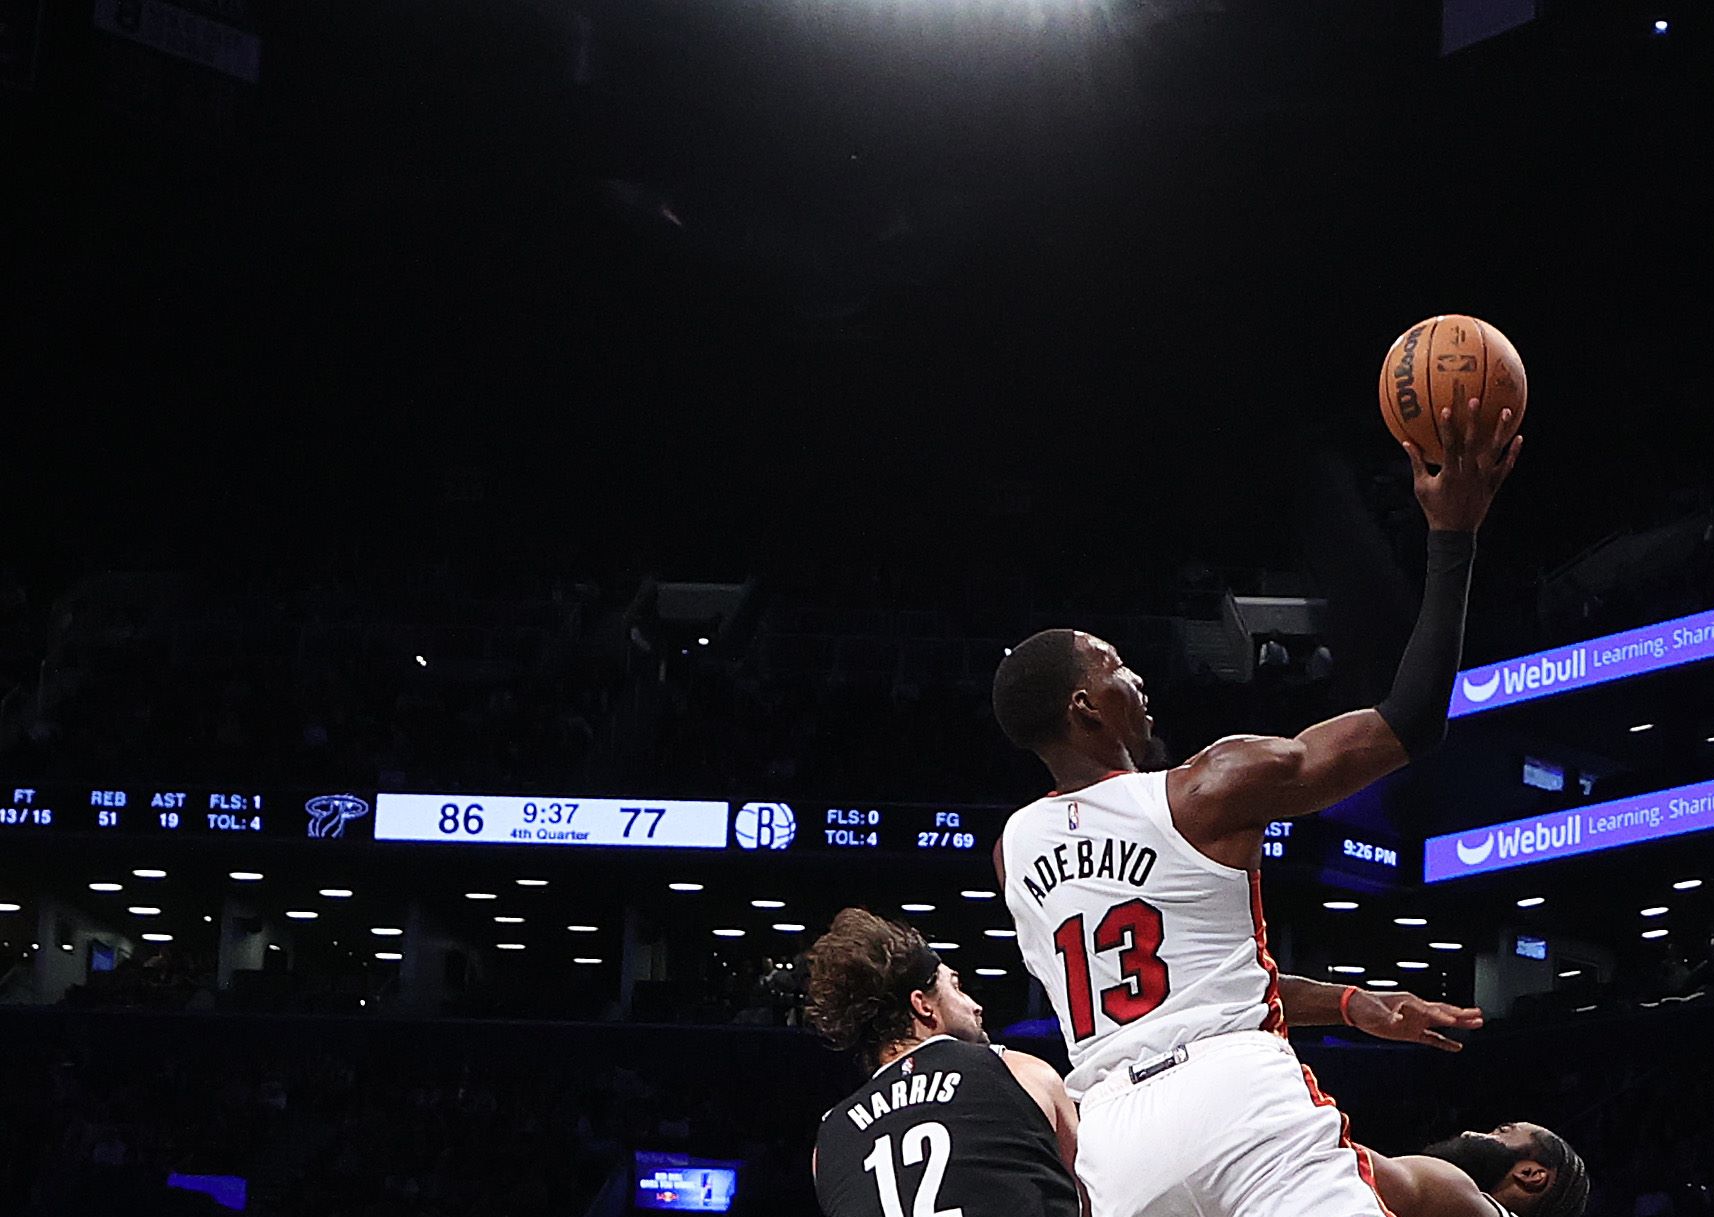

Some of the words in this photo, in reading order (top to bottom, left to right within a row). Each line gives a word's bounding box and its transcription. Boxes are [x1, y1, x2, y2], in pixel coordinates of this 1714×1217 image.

[1504, 648, 1586, 695] Webull
[1593, 637, 1668, 668] Learning.
[14, 789, 36, 803] FT
[91, 791, 127, 806] REB
[151, 793, 187, 808] AST
[98, 811, 118, 826] 51
[159, 813, 179, 828] 19
[437, 804, 485, 834] 86
[522, 803, 579, 824] 9:37
[618, 808, 667, 838] 77
[935, 813, 960, 827] FG
[537, 829, 590, 842] Quarter
[1498, 814, 1582, 859] Webull
[1588, 803, 1664, 835] Learning.
[1263, 842, 1284, 857] 18
[1343, 839, 1373, 861] 9:26
[1374, 847, 1398, 867] PM
[1023, 838, 1158, 908] ADEBAYO
[1053, 898, 1171, 1044] 13
[847, 1071, 963, 1132] HARRIS
